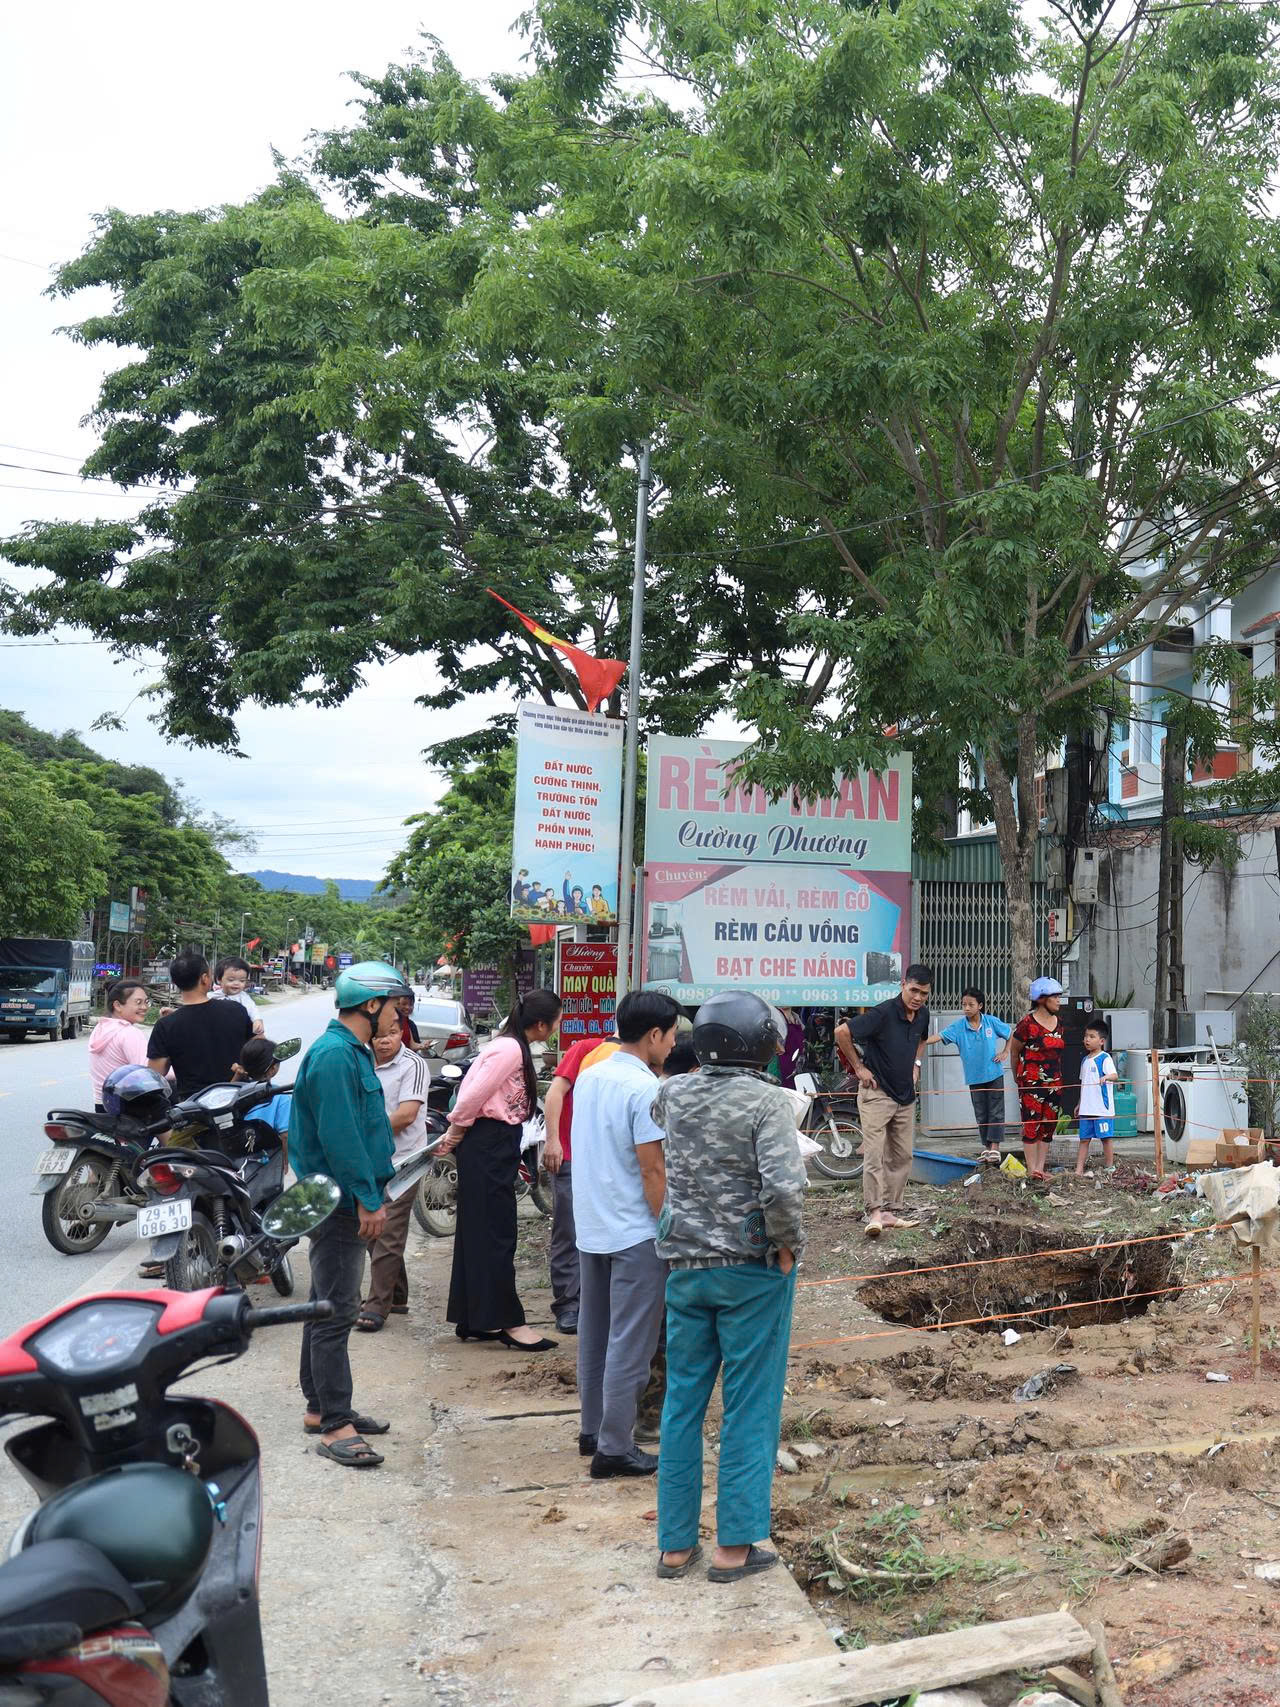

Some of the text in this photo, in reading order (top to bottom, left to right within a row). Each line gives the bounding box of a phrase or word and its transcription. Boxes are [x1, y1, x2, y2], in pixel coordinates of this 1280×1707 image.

[544, 760, 593, 775] ĐẤT NƯỚC
[533, 775, 602, 793] CƯỜNG THỊNH,
[536, 791, 576, 804] TRƯỜNG
[542, 806, 591, 821] ĐẤT NƯỚC
[568, 826, 594, 838] VINH,
[678, 819, 870, 860] Cường Phương
[535, 839, 595, 853] HẠNH PHÚC!
[655, 869, 708, 883] Chuyên:
[704, 880, 871, 912] RÈM VẢI, RÈM GỖ
[714, 916, 859, 943] RÈM CẦU VỒNG
[716, 951, 857, 981] BẠT CHE NẮNG
[563, 975, 588, 993] MAY
[592, 970, 617, 993] QUẦ
[676, 987, 713, 1001] 0983
[802, 989, 838, 1001] 0963
[844, 989, 869, 1001] 158
[1099, 1122, 1109, 1133] 10
